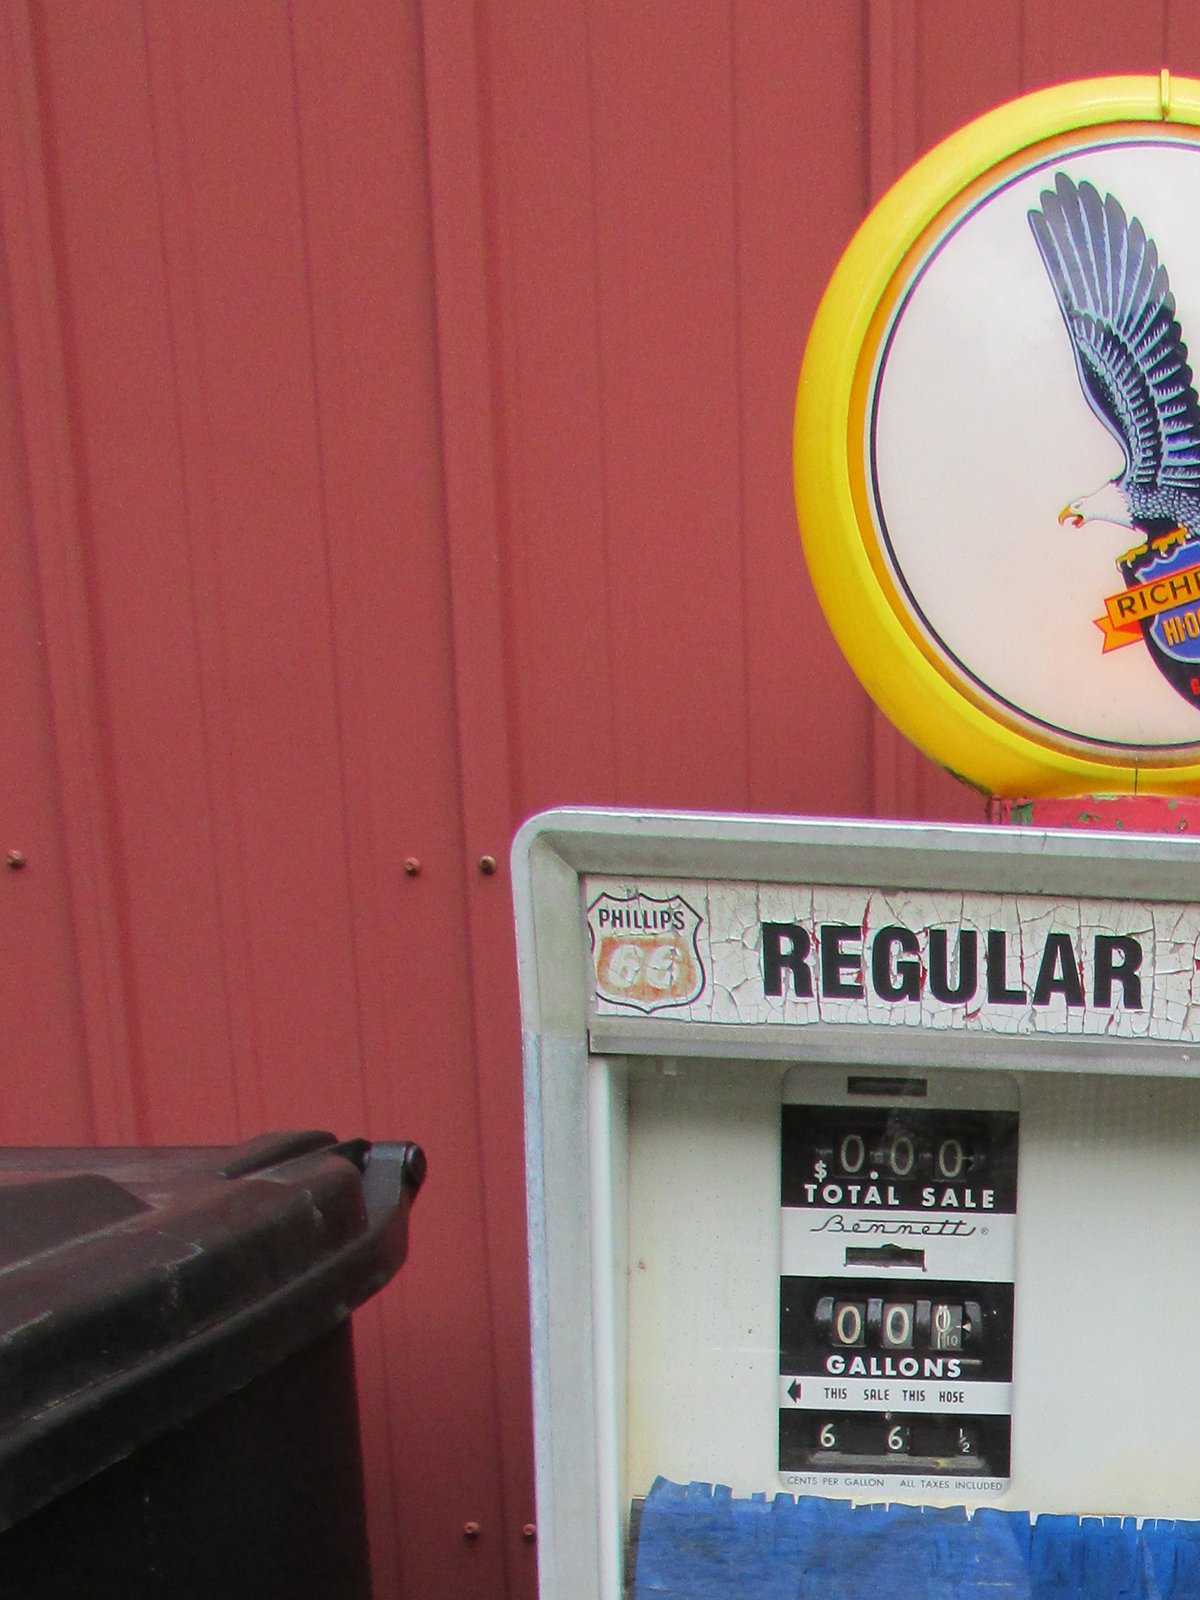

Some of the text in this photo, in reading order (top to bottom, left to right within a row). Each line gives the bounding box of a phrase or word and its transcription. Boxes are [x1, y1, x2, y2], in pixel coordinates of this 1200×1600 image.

[599, 909, 686, 931] PHILLIPS
[606, 942, 683, 987] 66
[761, 921, 1144, 1010] REGULAR
[804, 1184, 995, 1209] TOTAL SALE
[826, 1355, 961, 1378] GALLONS
[824, 1387, 965, 1403] THIS SALE THIS HOSE
[787, 1476, 1003, 1491] CENTS PER GALLON ALL TAXES INCLUDED
